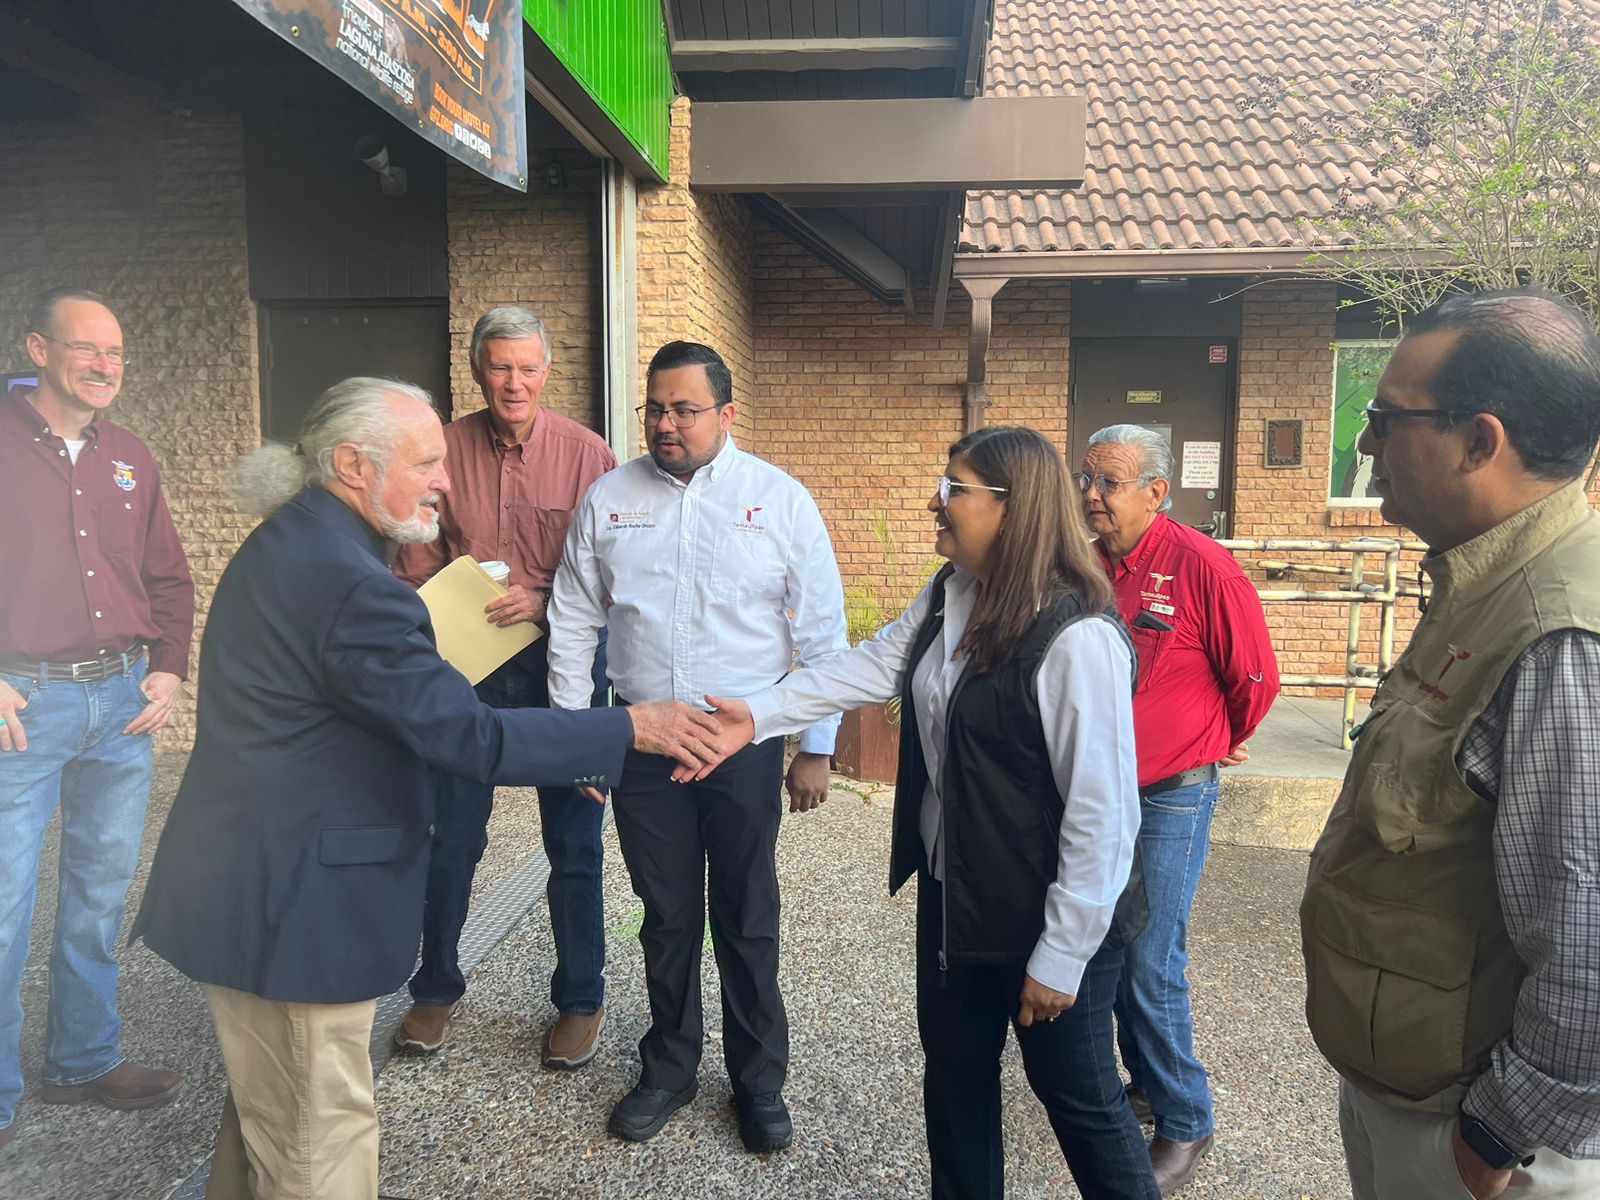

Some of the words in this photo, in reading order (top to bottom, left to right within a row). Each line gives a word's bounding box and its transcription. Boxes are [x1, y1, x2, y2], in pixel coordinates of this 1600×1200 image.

[339, 18, 378, 59] LAGUNA
[378, 50, 415, 91] ATASCOSA
[342, 0, 372, 37] friends
[373, 28, 383, 47] of
[336, 37, 370, 70] national
[370, 61, 393, 88] wildlife
[392, 80, 414, 105] refuge
